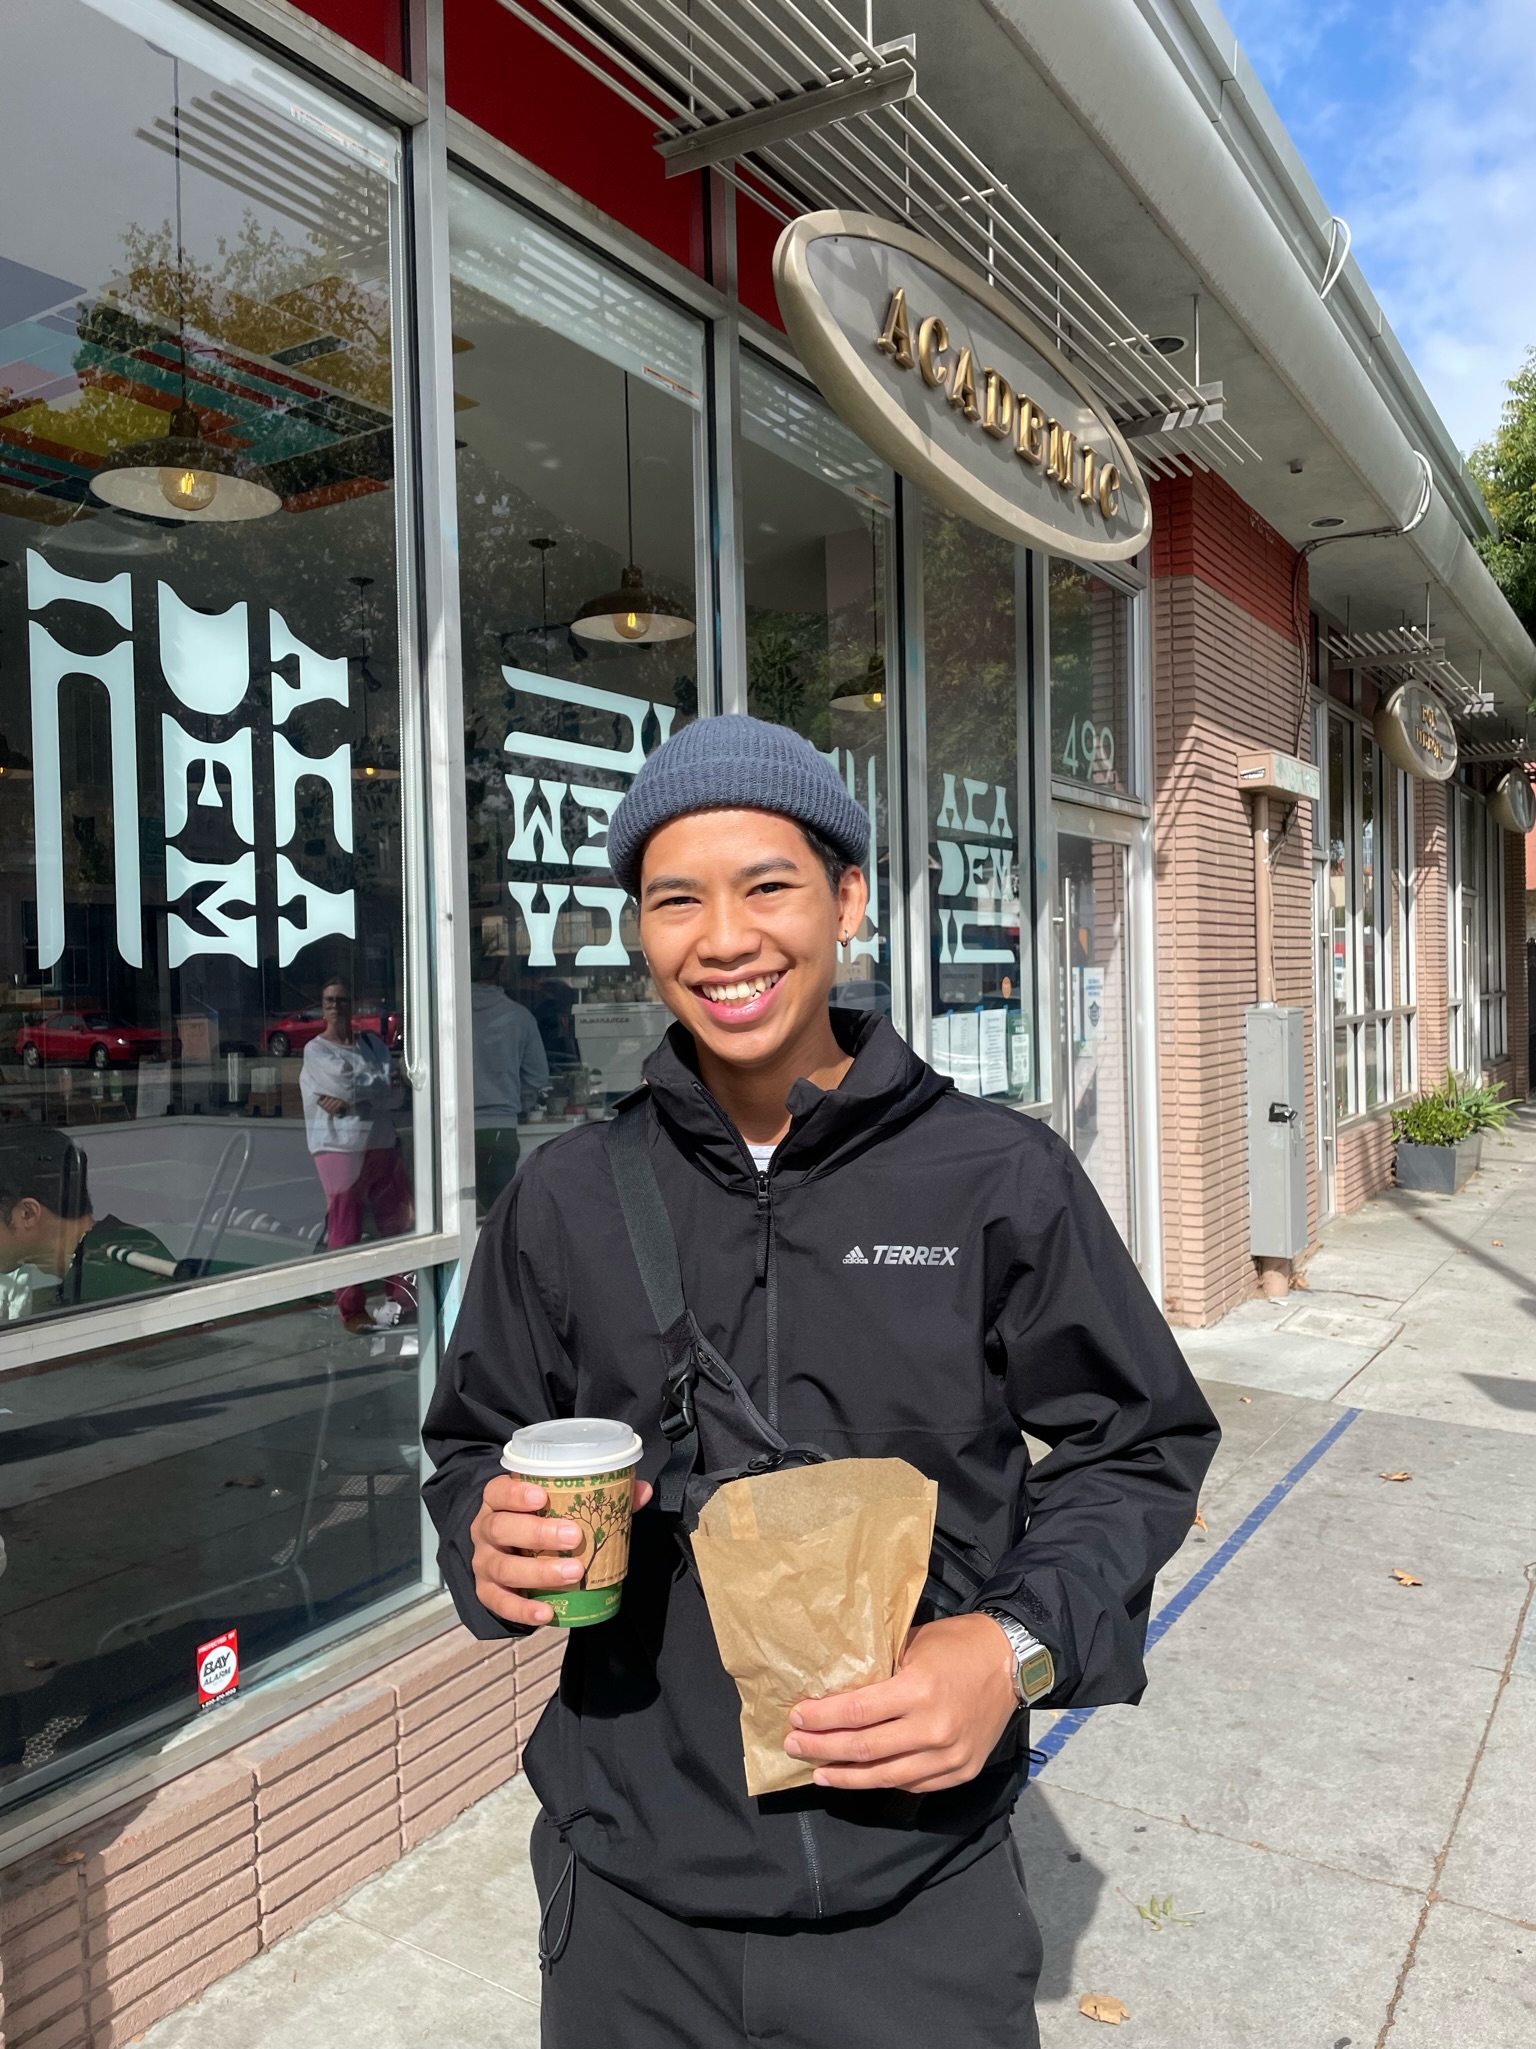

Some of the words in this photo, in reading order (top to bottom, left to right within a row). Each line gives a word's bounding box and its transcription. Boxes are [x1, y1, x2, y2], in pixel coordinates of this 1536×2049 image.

[876, 287, 1121, 519] ACADEMIC
[1062, 712, 1114, 785] 499
[937, 773, 1013, 839] ACA
[937, 840, 1014, 901] DEM
[939, 909, 1015, 963] IC
[842, 1257, 869, 1265] adidas
[873, 1245, 959, 1266] TERREX
[554, 1475, 585, 1488] OUR
[203, 1651, 231, 1678] BAY
[203, 1667, 231, 1687] ALARM
